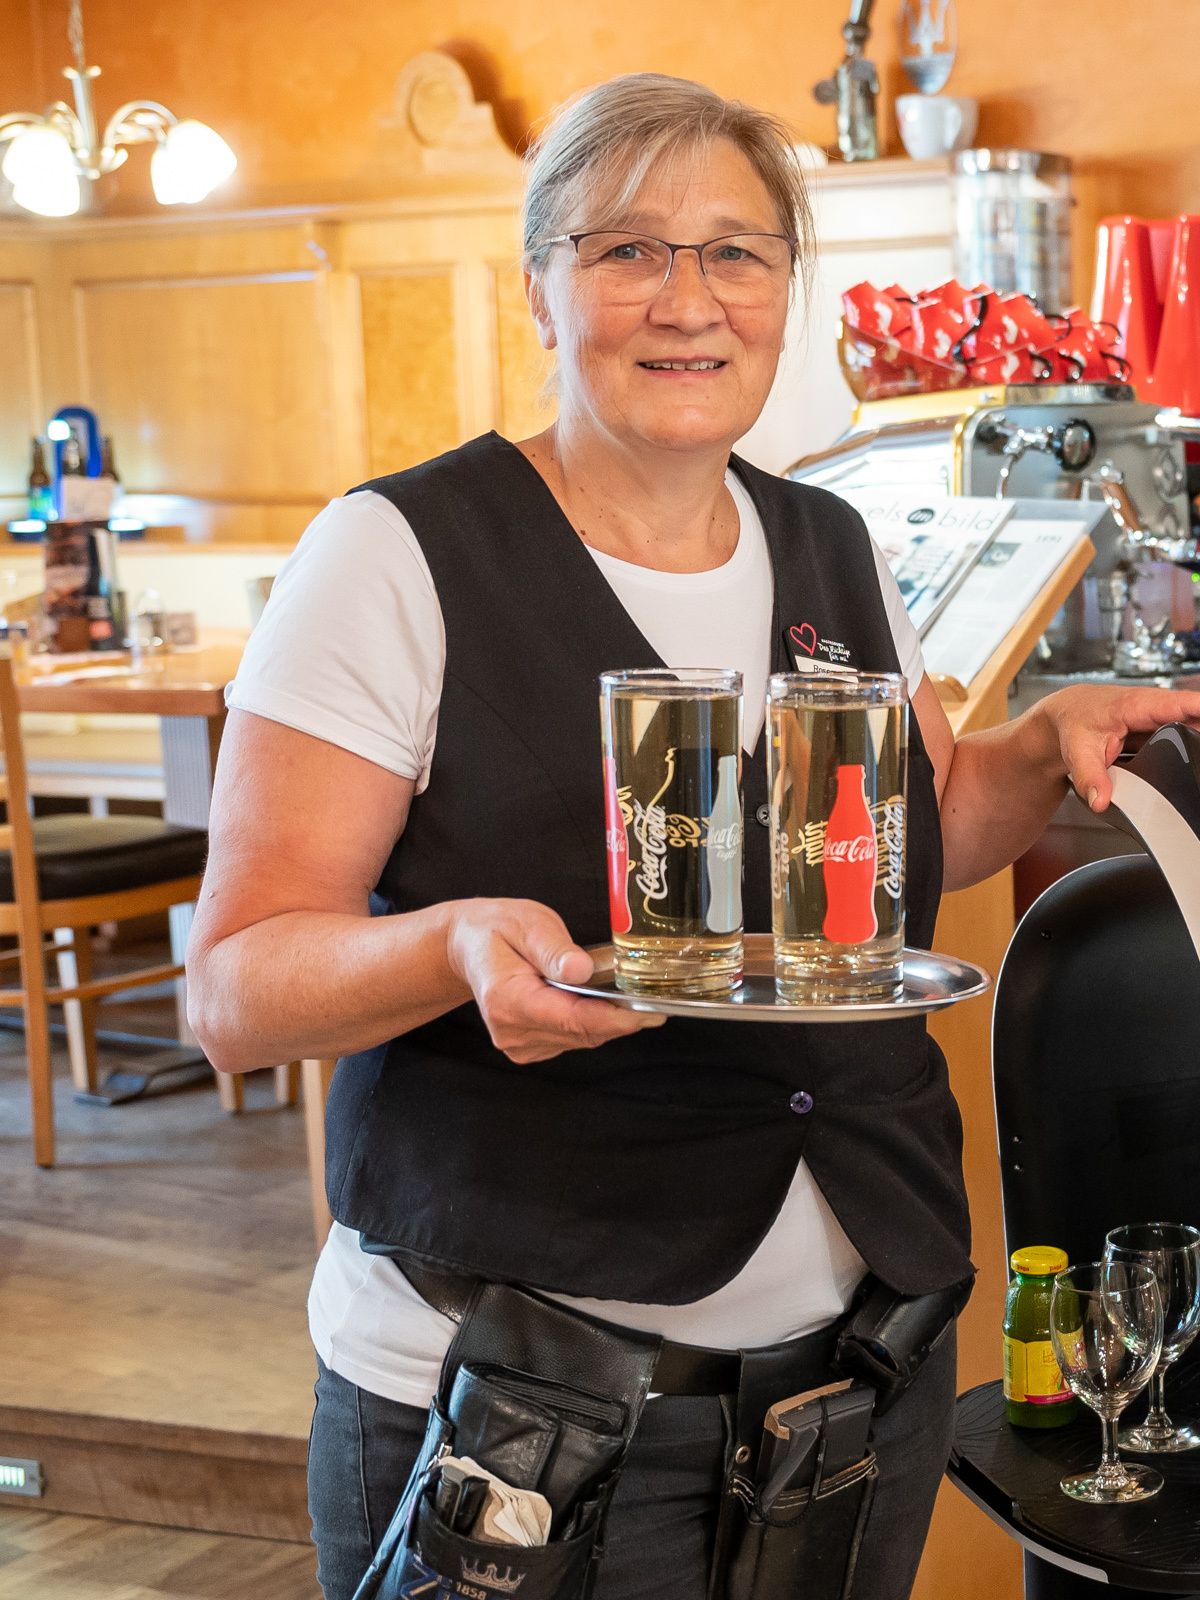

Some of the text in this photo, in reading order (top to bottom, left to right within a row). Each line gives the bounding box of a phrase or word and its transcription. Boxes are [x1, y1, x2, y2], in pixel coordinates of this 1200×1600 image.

[909, 508, 934, 524] im
[938, 508, 999, 533] bild
[633, 798, 669, 900] Coca-Cola
[883, 801, 905, 900] Coca-Cola
[455, 1581, 488, 1600] 1858
